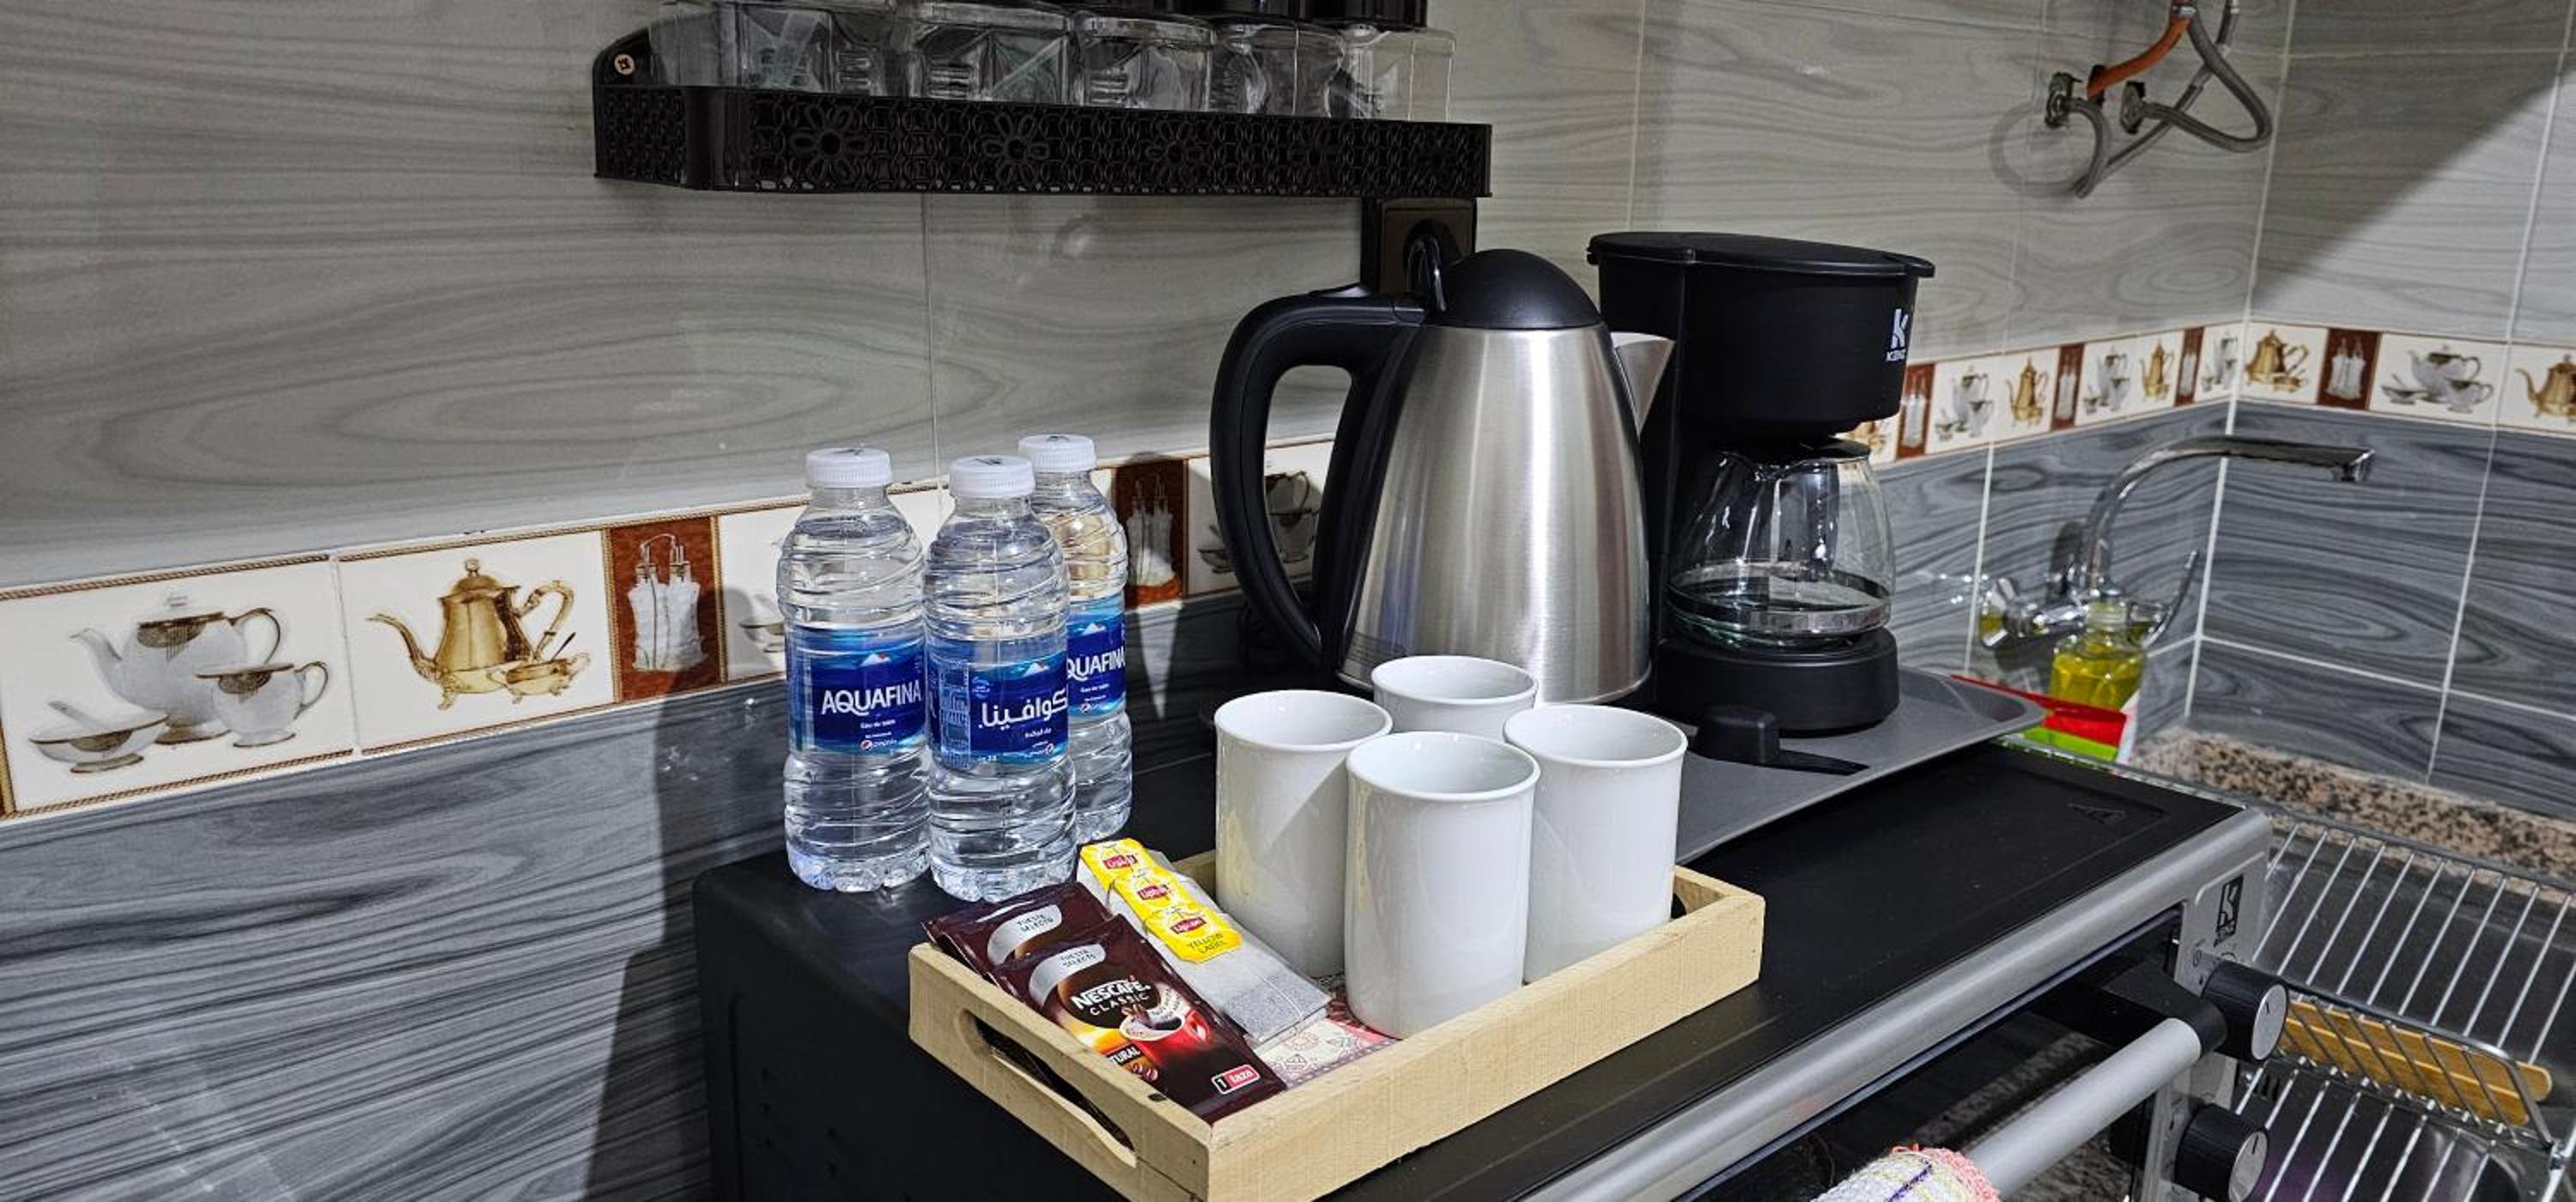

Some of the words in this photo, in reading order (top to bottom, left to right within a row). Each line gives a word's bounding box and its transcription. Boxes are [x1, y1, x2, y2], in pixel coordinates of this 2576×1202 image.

[1066, 646, 1127, 682] QUAFINA
[822, 679, 922, 716] AQUAFINA
[981, 689, 1067, 730] كوافينا
[1090, 993, 1150, 1017] CLASSIC
[1110, 1046, 1142, 1065] TURAL
[1217, 1078, 1227, 1089] 1
